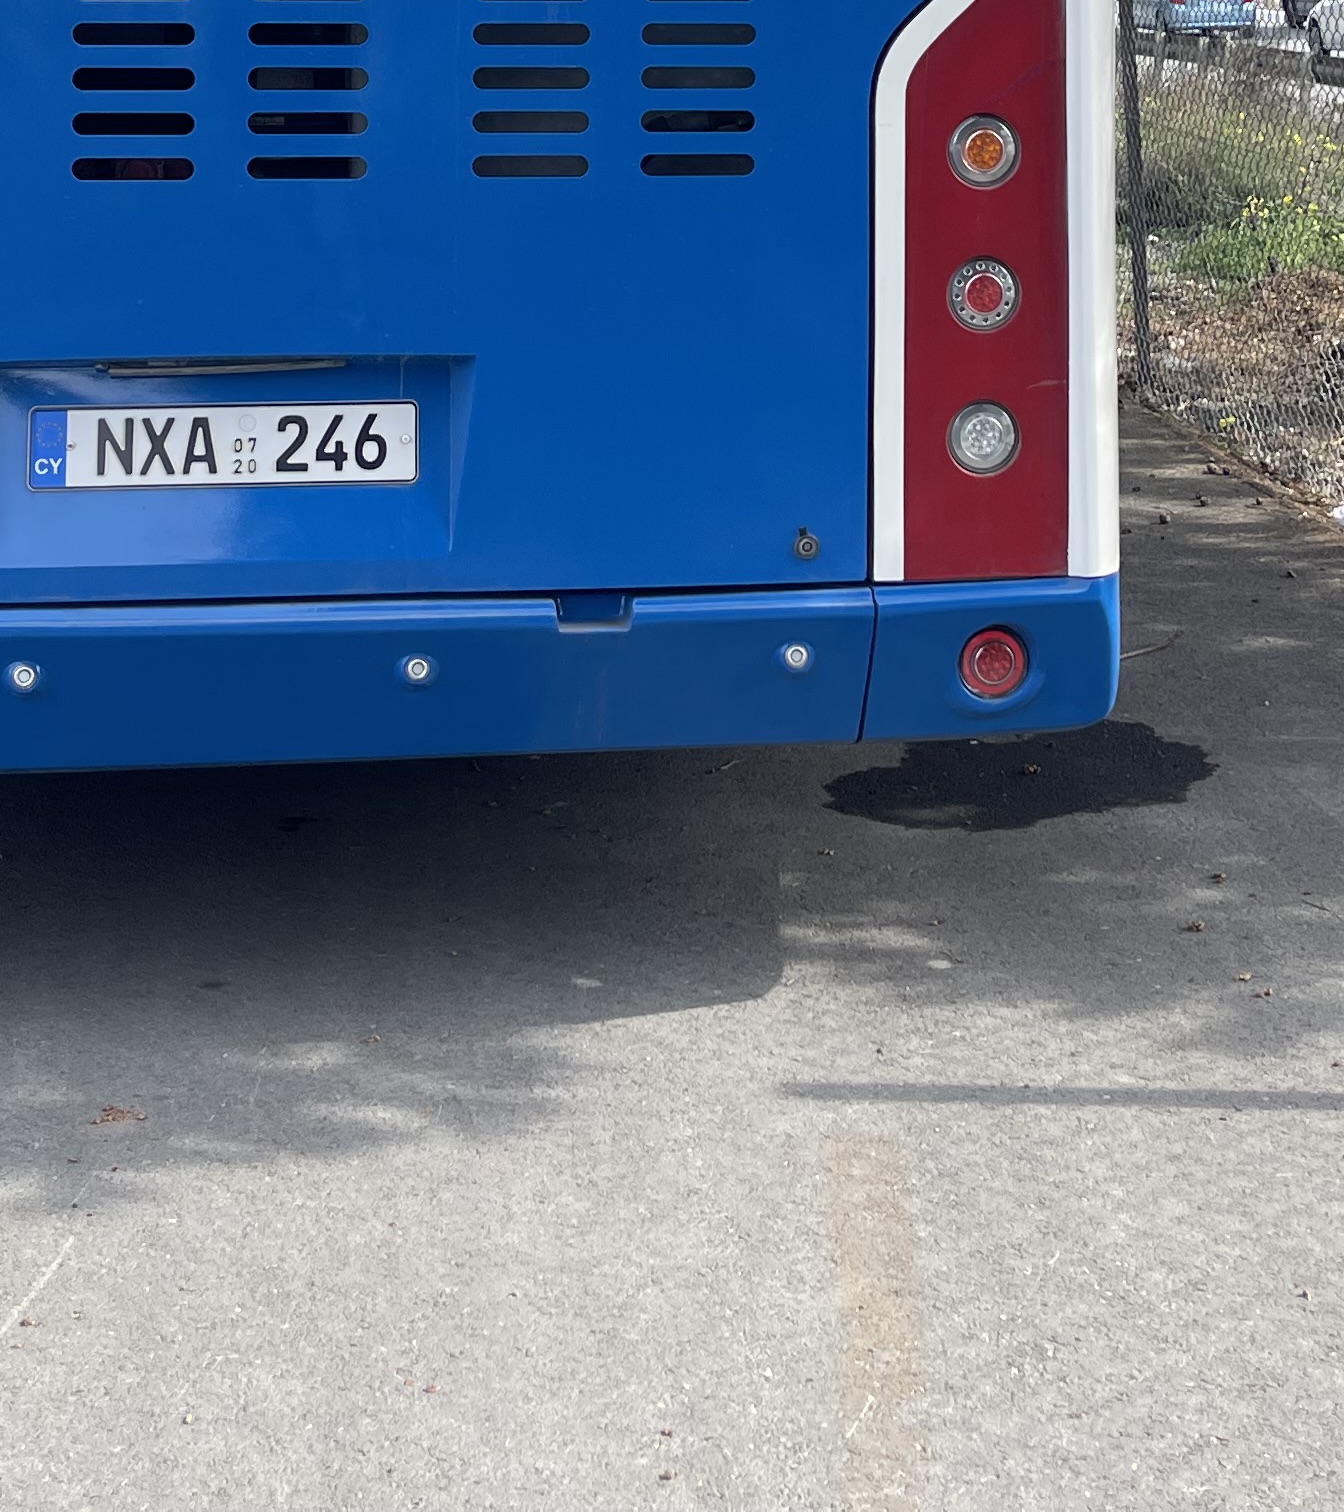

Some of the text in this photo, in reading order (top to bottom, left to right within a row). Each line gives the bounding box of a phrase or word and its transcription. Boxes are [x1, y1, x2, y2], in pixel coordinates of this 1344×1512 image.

[97, 417, 218, 476] NXA
[234, 438, 257, 453] 07
[275, 413, 387, 473] 246
[35, 459, 62, 476] CY
[233, 459, 257, 474] 20
